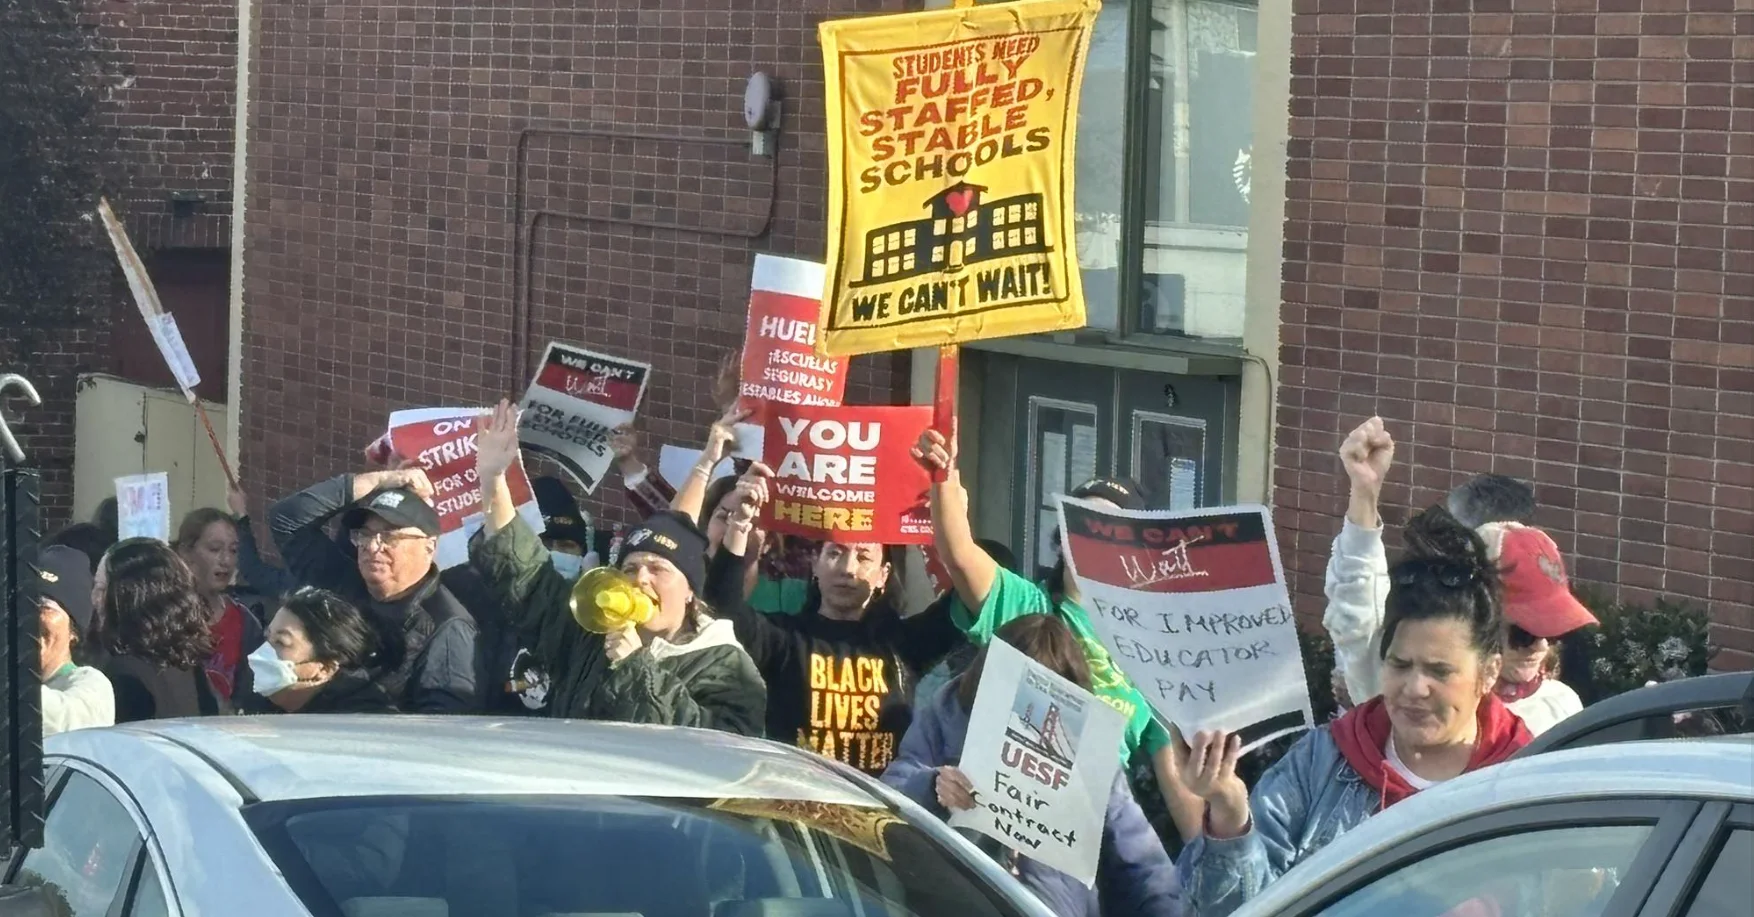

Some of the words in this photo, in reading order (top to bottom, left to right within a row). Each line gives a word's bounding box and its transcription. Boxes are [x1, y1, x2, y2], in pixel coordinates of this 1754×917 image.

[893, 42, 985, 79] STUDENTS
[992, 33, 1040, 60] NEED
[896, 56, 1027, 103] FULLY
[860, 78, 1054, 136] STAFFED,
[871, 105, 1028, 163] STABLE
[860, 127, 1050, 194] SCHOOLS
[852, 292, 890, 323] WE
[898, 276, 970, 315] CAN'T
[977, 263, 1051, 300] WAIT!
[760, 315, 816, 346] HUEL
[561, 354, 587, 369] WE
[527, 400, 565, 420] FOR
[742, 383, 802, 405] ESTABLES
[433, 419, 472, 436] ON
[778, 416, 881, 451] YOU
[418, 433, 478, 471] STRIK
[776, 451, 877, 485] ARE
[434, 473, 464, 496] FOR
[776, 483, 875, 503] WELCOME
[437, 489, 482, 517] STUDE
[774, 500, 873, 531] HERE
[1085, 517, 1135, 541] WE
[1142, 519, 1240, 544] CAN'T
[1119, 535, 1209, 586] Wait
[1092, 597, 1148, 631] FOR
[1156, 604, 1294, 636] IMPROVED
[1113, 634, 1278, 668] EDUCATOR
[810, 653, 889, 693] BLACK
[1155, 677, 1216, 702] PAY
[810, 690, 880, 731] LIVES
[1001, 741, 1070, 791] UESF
[993, 770, 1050, 810] Fair
[995, 816, 1042, 850] Now
